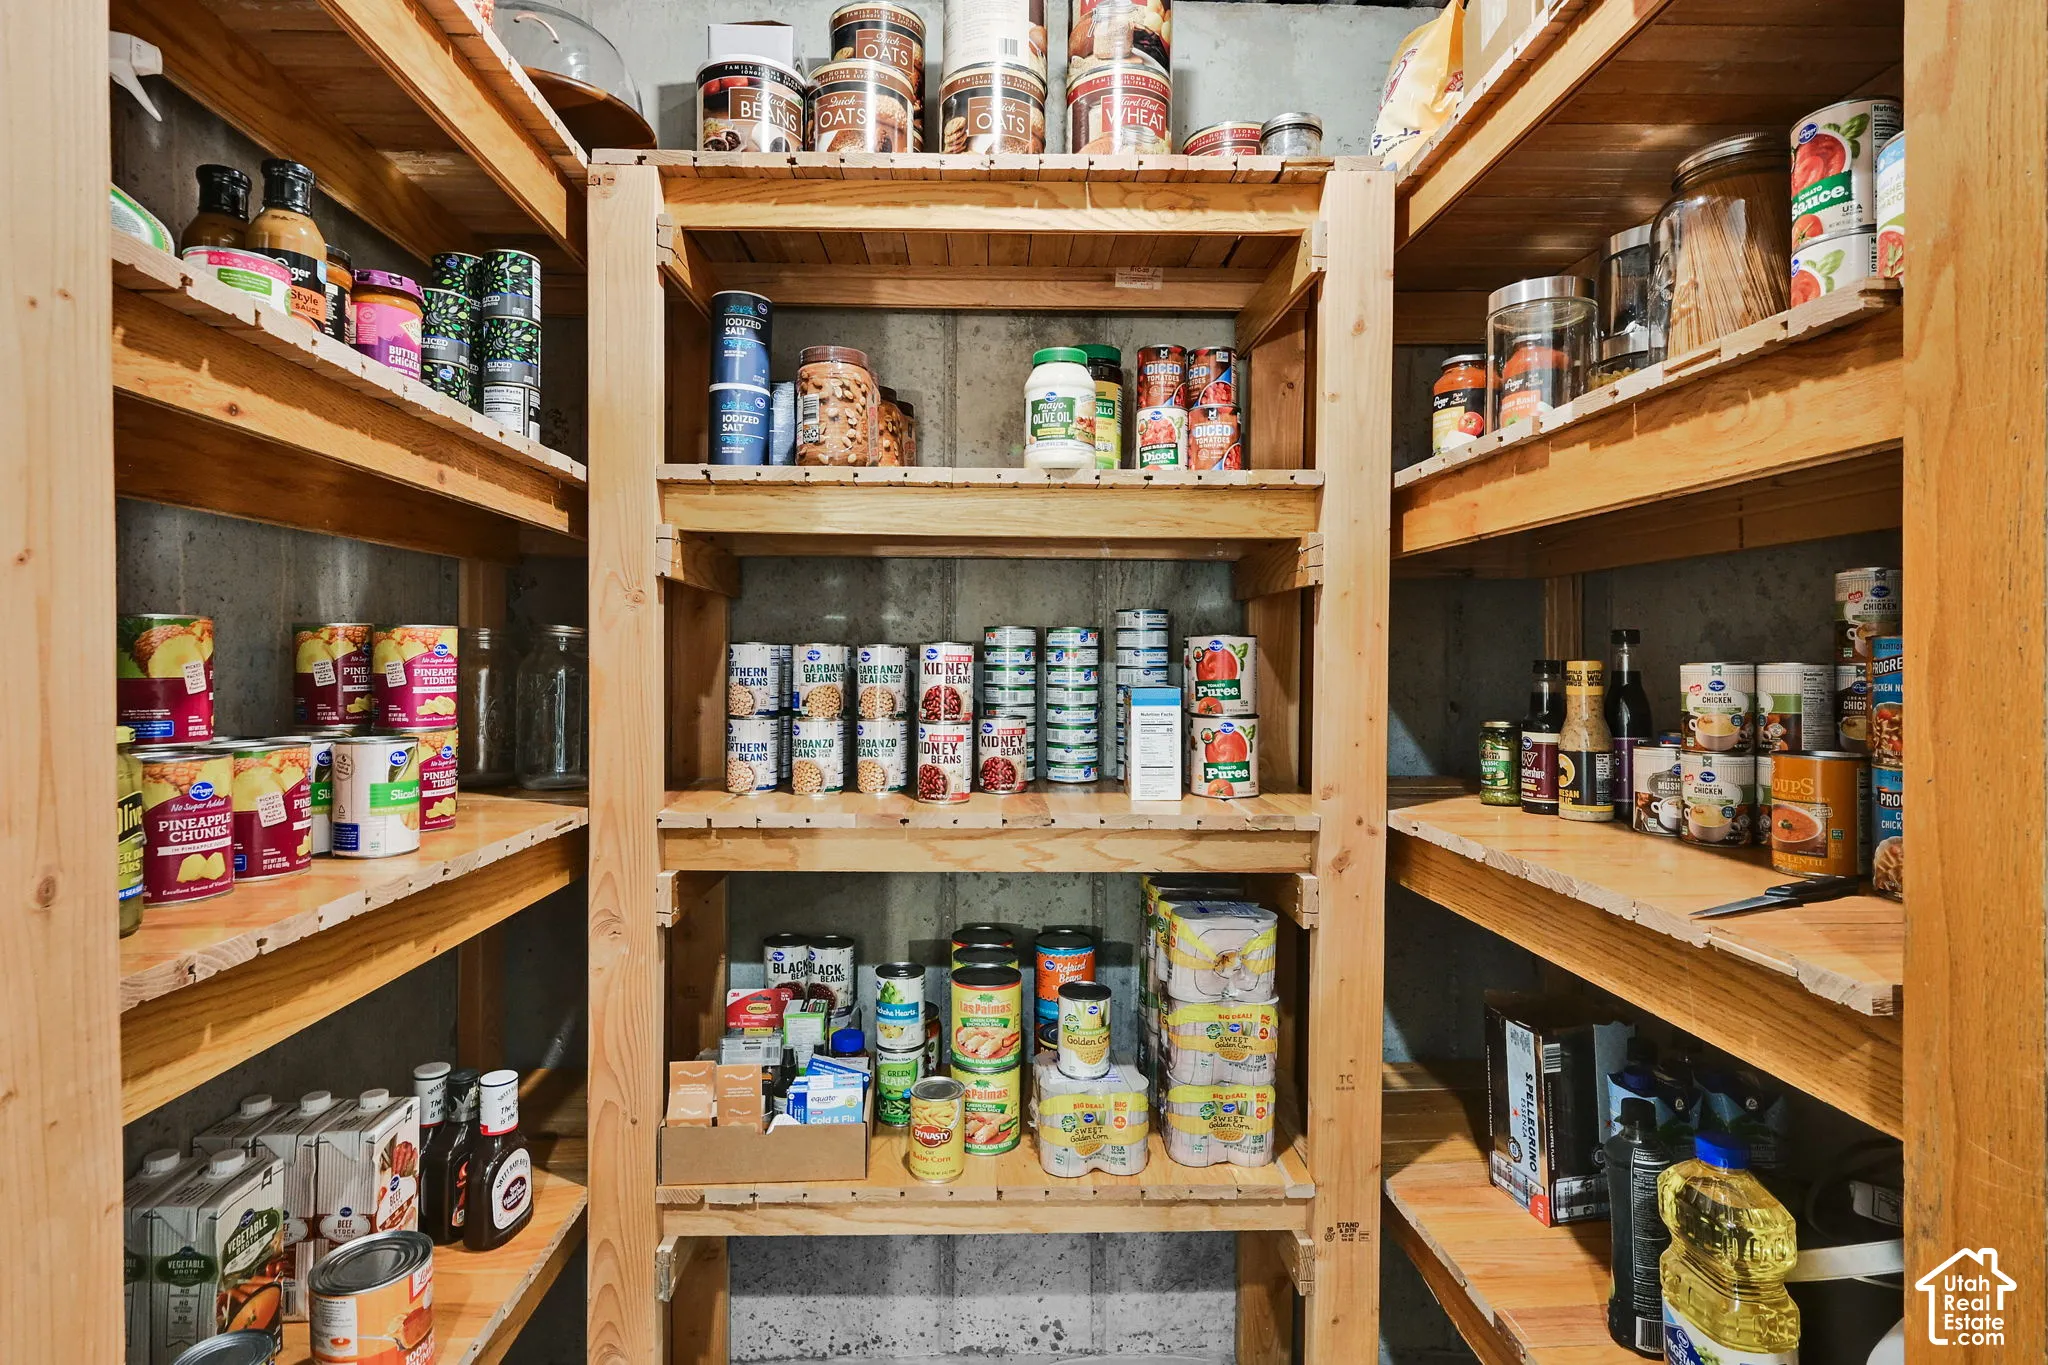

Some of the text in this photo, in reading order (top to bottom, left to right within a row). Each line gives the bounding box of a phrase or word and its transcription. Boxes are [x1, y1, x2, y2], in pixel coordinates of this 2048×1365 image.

[863, 44, 908, 66] OATS
[826, 96, 856, 108] Quick
[740, 101, 797, 131] BEANS
[819, 108, 867, 129] OATS
[1104, 107, 1164, 131] WHEAT
[976, 112, 1026, 134] OATS
[1792, 185, 1846, 219] Sauce
[290, 288, 319, 306] Style
[295, 303, 320, 316] SAUCE
[725, 317, 762, 330] IODIZED
[724, 326, 747, 336] SALT
[388, 345, 418, 360] BUTTER
[487, 361, 513, 369] SLICED
[1146, 364, 1181, 375] DICED
[1038, 402, 1065, 412] mayo
[722, 414, 760, 425] IODIZED
[1033, 411, 1072, 425] OLIVE OIL
[722, 423, 744, 432] SALT
[1195, 425, 1232, 438] DICED
[1142, 449, 1175, 463] Diced
[1863, 603, 1897, 611] CHICKEN
[858, 664, 904, 675] GARBANZO
[924, 663, 969, 675] KIDNEY
[1873, 657, 1903, 675] PROGRE
[413, 668, 457, 676] PINEAPPLE
[729, 667, 768, 677] RTHERN
[422, 676, 454, 685] TIDBITS
[738, 678, 768, 686] BEANS
[805, 673, 838, 683] BEANS
[945, 675, 971, 684] BEANS
[1197, 686, 1238, 698] Puree
[1702, 696, 1732, 704] CHICKEN
[728, 742, 768, 752] RTHERN
[793, 739, 834, 749] ARBANZO
[858, 739, 897, 749] ARBANZO
[981, 735, 1023, 748] KIDNEY
[793, 749, 817, 758] EANS
[919, 742, 958, 754] IDNEY
[1000, 747, 1025, 756] BEANS
[738, 753, 768, 762] BEANS
[930, 755, 962, 764] BEANS
[1206, 768, 1249, 779] Puree
[190, 784, 214, 798] Kroger
[1657, 781, 1680, 790] MUSH
[1693, 786, 1723, 796] CHICKEN
[1772, 777, 1815, 796] OUPS
[259, 794, 280, 802] PICKED
[390, 788, 416, 801] Sliced
[170, 798, 225, 812] No Sugar Added
[260, 803, 282, 812] PACKED
[158, 812, 231, 832] PINEAPPLE
[169, 825, 227, 843] CHUNKS
[180, 843, 212, 851] PINEAPPLE
[162, 887, 189, 896] Excellent
[772, 961, 808, 975] BLACK
[808, 963, 842, 976] BLACK
[1055, 959, 1087, 975] Refried
[820, 973, 845, 982] BEANS
[1059, 973, 1083, 983] Beans
[895, 1008, 916, 1017] Hearts
[959, 1001, 1012, 1015] Las Palmas
[1067, 1034, 1096, 1046] Golden
[1237, 1042, 1253, 1050] Corn
[880, 1076, 912, 1087] BEANS
[1338, 1074, 1354, 1084] TC
[810, 1095, 836, 1103] equate
[971, 1089, 1008, 1100] Palmas
[430, 1099, 442, 1109] The
[1073, 1102, 1085, 1110] BIG
[430, 1111, 437, 1119] is
[500, 1106, 511, 1115] The
[810, 1116, 831, 1124] Cold
[841, 1115, 856, 1123] Flu
[1525, 1072, 1538, 1173] S.PELLEGRINO
[1208, 1121, 1250, 1130] Golden Corn
[914, 1128, 950, 1141] DYNASTY
[1075, 1127, 1103, 1136] SWEET
[1070, 1134, 1092, 1143] Golden
[912, 1151, 929, 1163] Baby
[496, 1170, 510, 1190] SWEET
[1536, 1201, 1544, 1220] NEW
[337, 1219, 353, 1229] BEEF
[227, 1214, 269, 1255] VEGETABLE
[236, 1234, 259, 1256] BROTH
[167, 1260, 205, 1269] VEGETABLE
